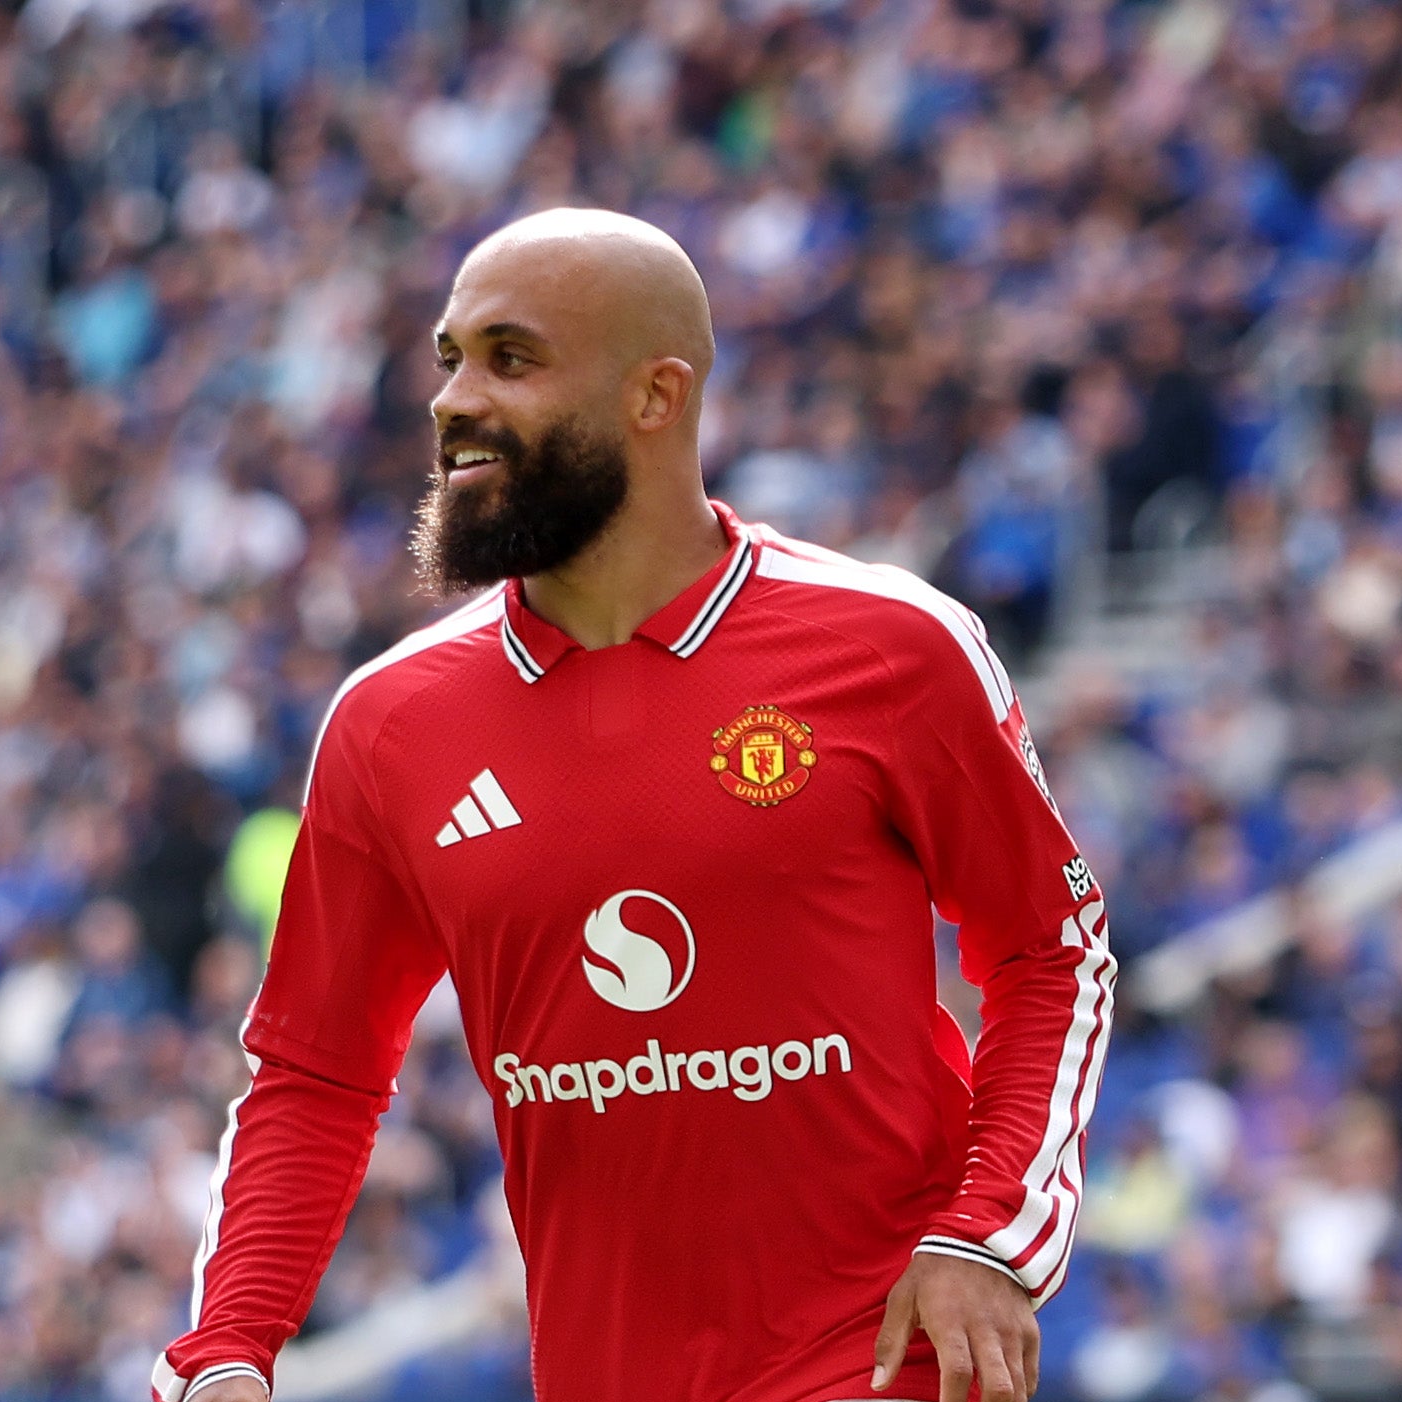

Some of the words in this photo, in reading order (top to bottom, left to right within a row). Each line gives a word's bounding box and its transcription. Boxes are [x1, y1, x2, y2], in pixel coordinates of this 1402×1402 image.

[721, 713, 805, 747] MANCHESTER
[736, 781, 795, 798] UNITED
[494, 1034, 852, 1114] Snapdragon
